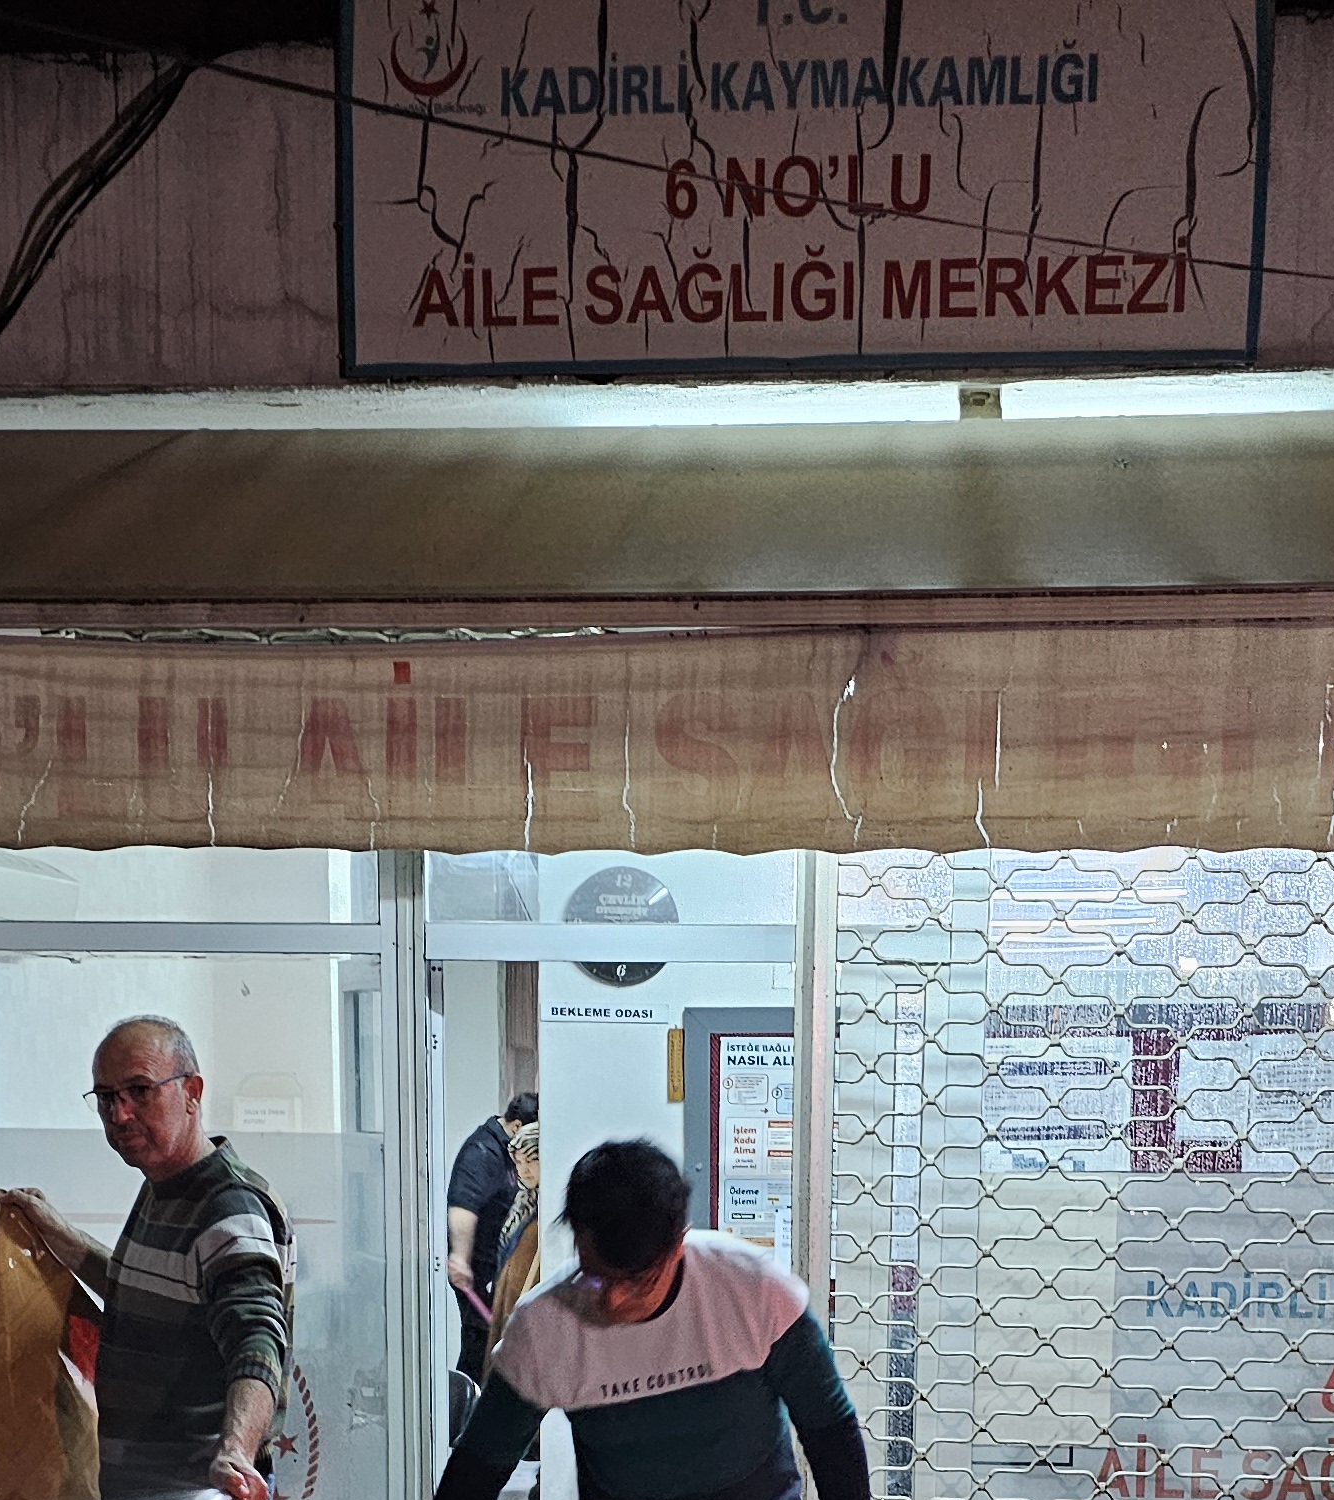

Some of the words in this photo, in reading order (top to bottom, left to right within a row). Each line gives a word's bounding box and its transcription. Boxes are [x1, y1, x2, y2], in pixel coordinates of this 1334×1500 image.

[499, 52, 688, 119] KADİRLİ
[710, 41, 1099, 113] KAYMAKAMLIĞI
[667, 158, 696, 220] 6
[413, 252, 560, 327] AİLE
[585, 244, 855, 324] SAĞLIĞI
[882, 237, 1187, 319] MERKEZİ
[551, 1007, 611, 1018] BEKLEME
[615, 1008, 653, 1019] ODASI
[727, 1041, 760, 1052] İSTEĞE
[727, 1056, 769, 1066] NASIL
[733, 1124, 757, 1135] İşlem
[733, 1136, 756, 1145] Kodu
[733, 1146, 756, 1154] Alma
[729, 1185, 759, 1195] Ödeme
[731, 1196, 757, 1206] İşlemi
[1146, 1272, 1327, 1320] KADİRLİ
[600, 1377, 640, 1399] TAKE
[1097, 1434, 1223, 1499] AİLE
